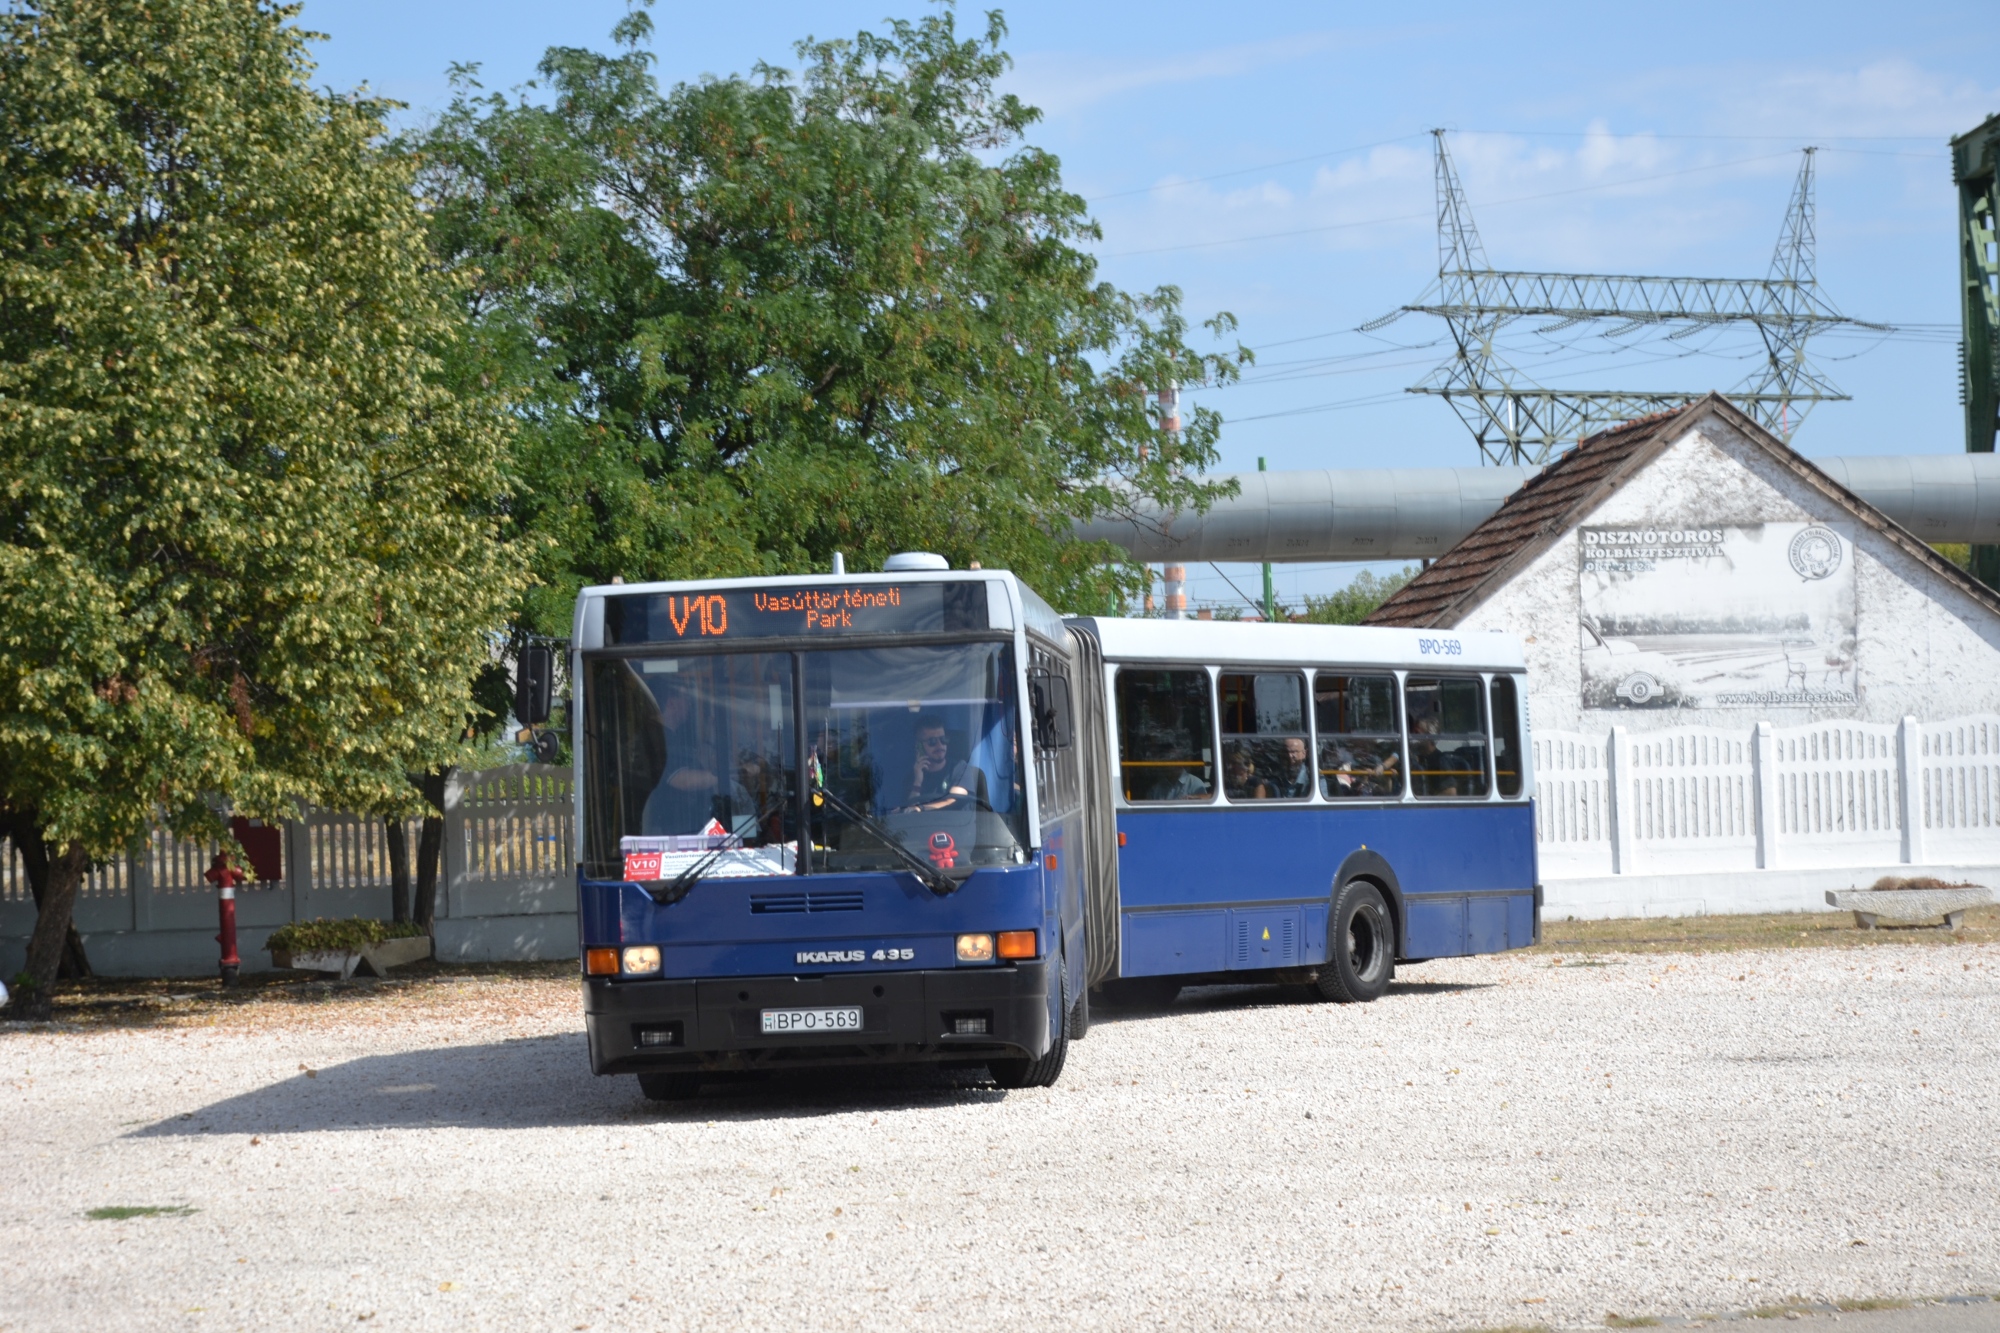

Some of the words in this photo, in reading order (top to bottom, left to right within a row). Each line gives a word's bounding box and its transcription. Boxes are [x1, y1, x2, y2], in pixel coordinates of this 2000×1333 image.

[1586, 527, 1723, 545] DISZNÓTOROS
[1586, 546, 1724, 559] KOLBÁSZFESZTIVÁL
[755, 588, 900, 612] Vasúttörténeti
[669, 595, 727, 636] V10
[807, 608, 852, 629] Park
[1419, 638, 1461, 655] BPO-569
[1716, 690, 1853, 704] www.kolbaszfeszt.hu
[632, 860, 657, 869] V10
[796, 950, 865, 963] IKARUS
[872, 948, 915, 961] 435
[764, 1022, 773, 1030] H
[777, 1011, 858, 1029] BPO-569
